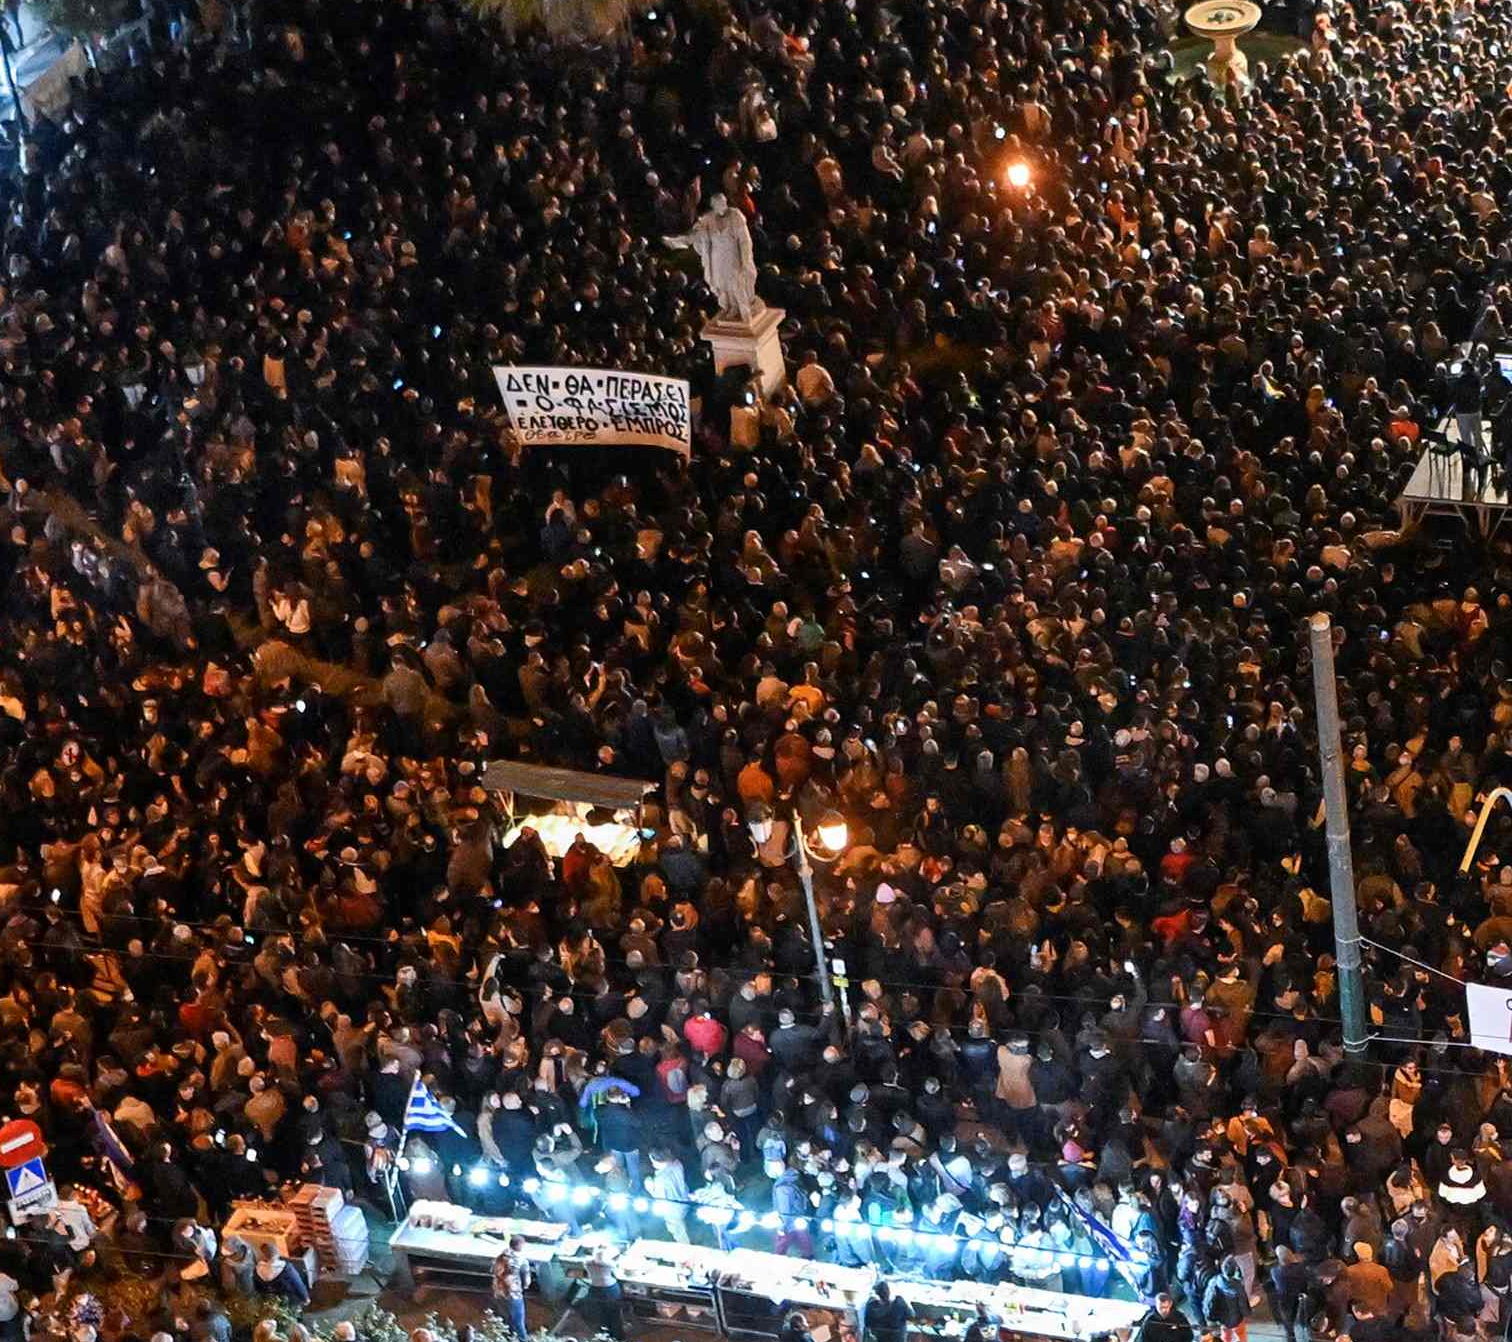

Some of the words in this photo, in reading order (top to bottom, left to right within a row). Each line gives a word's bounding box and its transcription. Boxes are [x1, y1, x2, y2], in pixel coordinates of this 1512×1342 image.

[506, 373, 550, 396] ΔΕΝ
[564, 374, 595, 396] ΘΑ
[606, 376, 686, 404] ΠΕΡΑΣΕΙ
